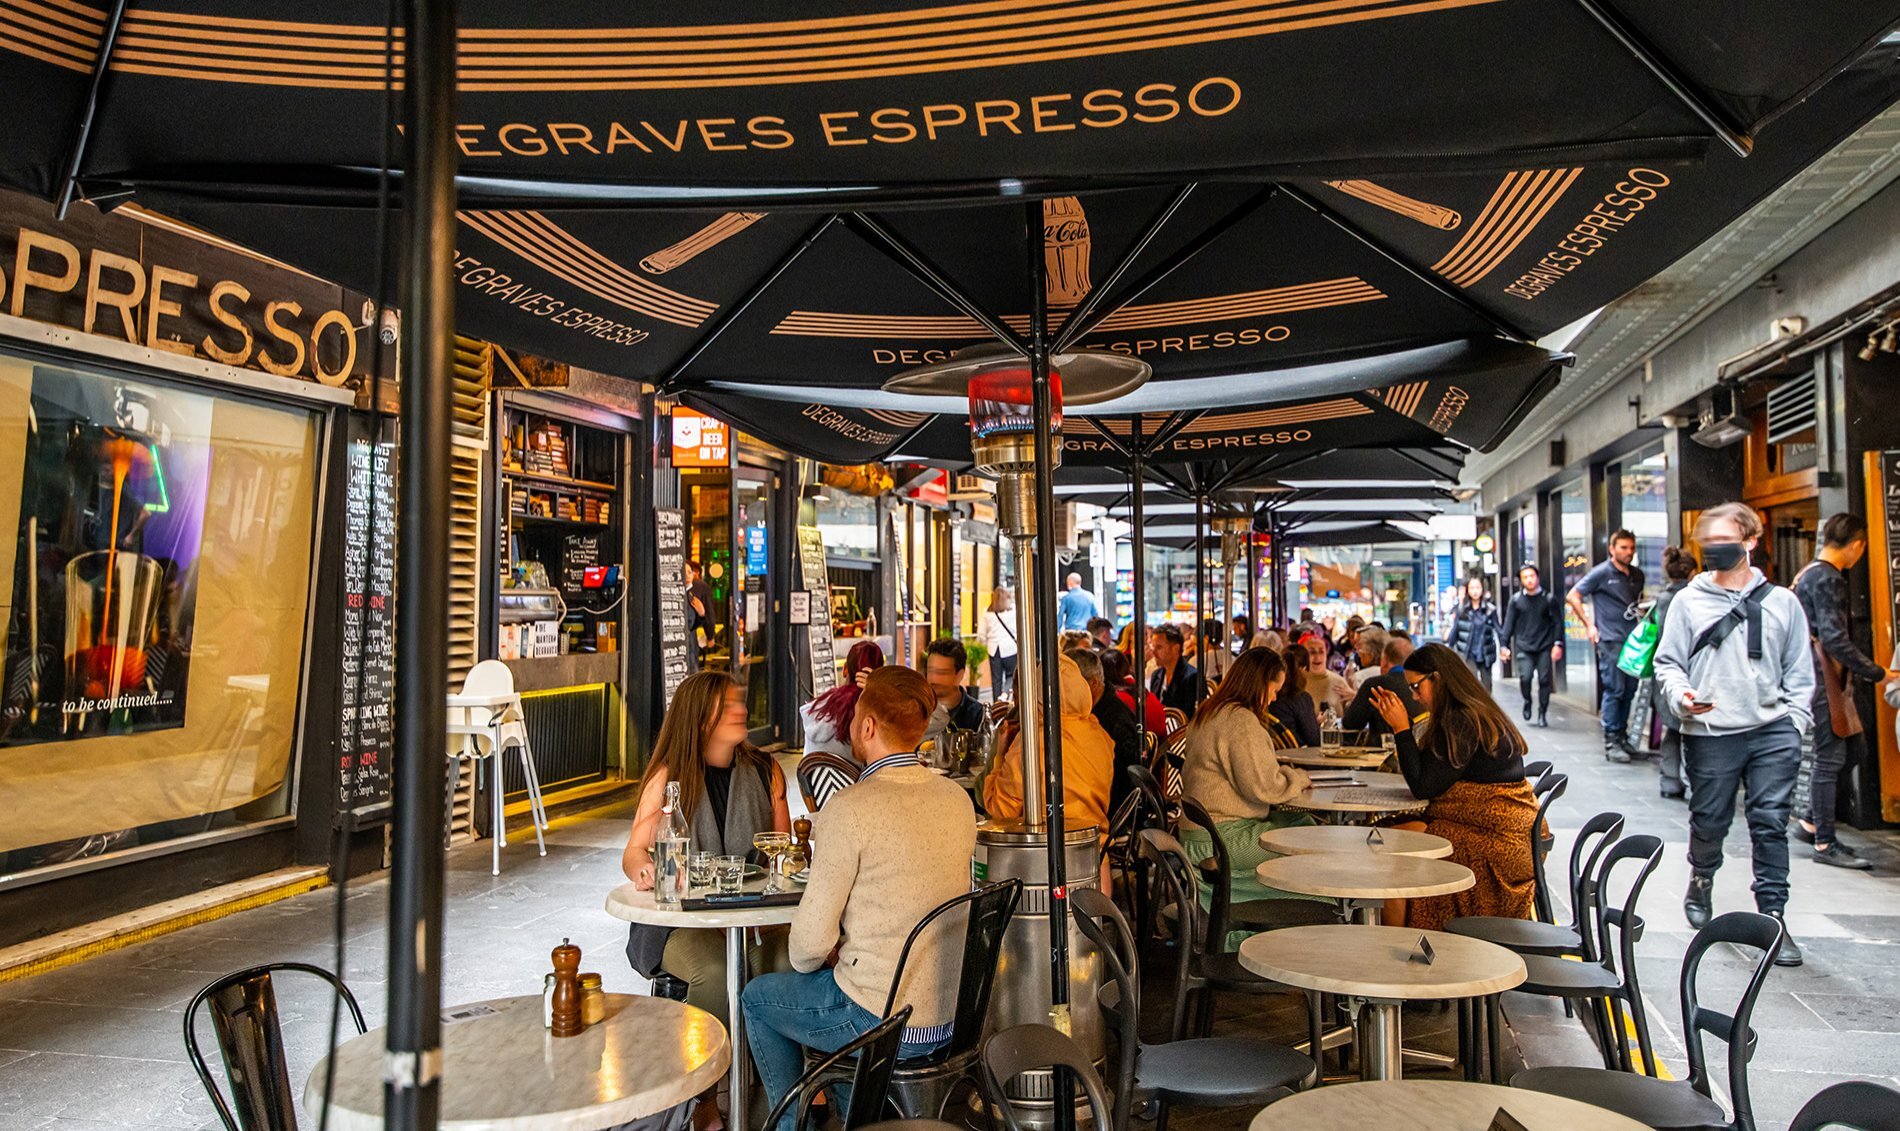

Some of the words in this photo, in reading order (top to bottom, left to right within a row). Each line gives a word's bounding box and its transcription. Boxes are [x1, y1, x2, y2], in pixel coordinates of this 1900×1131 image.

[397, 115, 795, 158] EGRAVES
[818, 76, 1242, 146] ESPRESSO
[1503, 251, 1583, 300] DEGRAVES
[1557, 167, 1671, 256] ESPRESSO
[0, 227, 357, 387] PRESSO
[454, 250, 565, 316] EGRAVES
[551, 307, 650, 346] ESPRESSO
[1085, 325, 1291, 355] SPRESSO
[801, 402, 867, 439] DEGRAVES
[356, 438, 390, 456] DEGAVES
[702, 432, 723, 446] BEER
[1173, 430, 1312, 450] ESPRESSO
[699, 446, 711, 460] ON
[711, 446, 727, 460] TAP
[347, 594, 364, 607] RED
[62, 700, 77, 713] to
[79, 697, 95, 712] be
